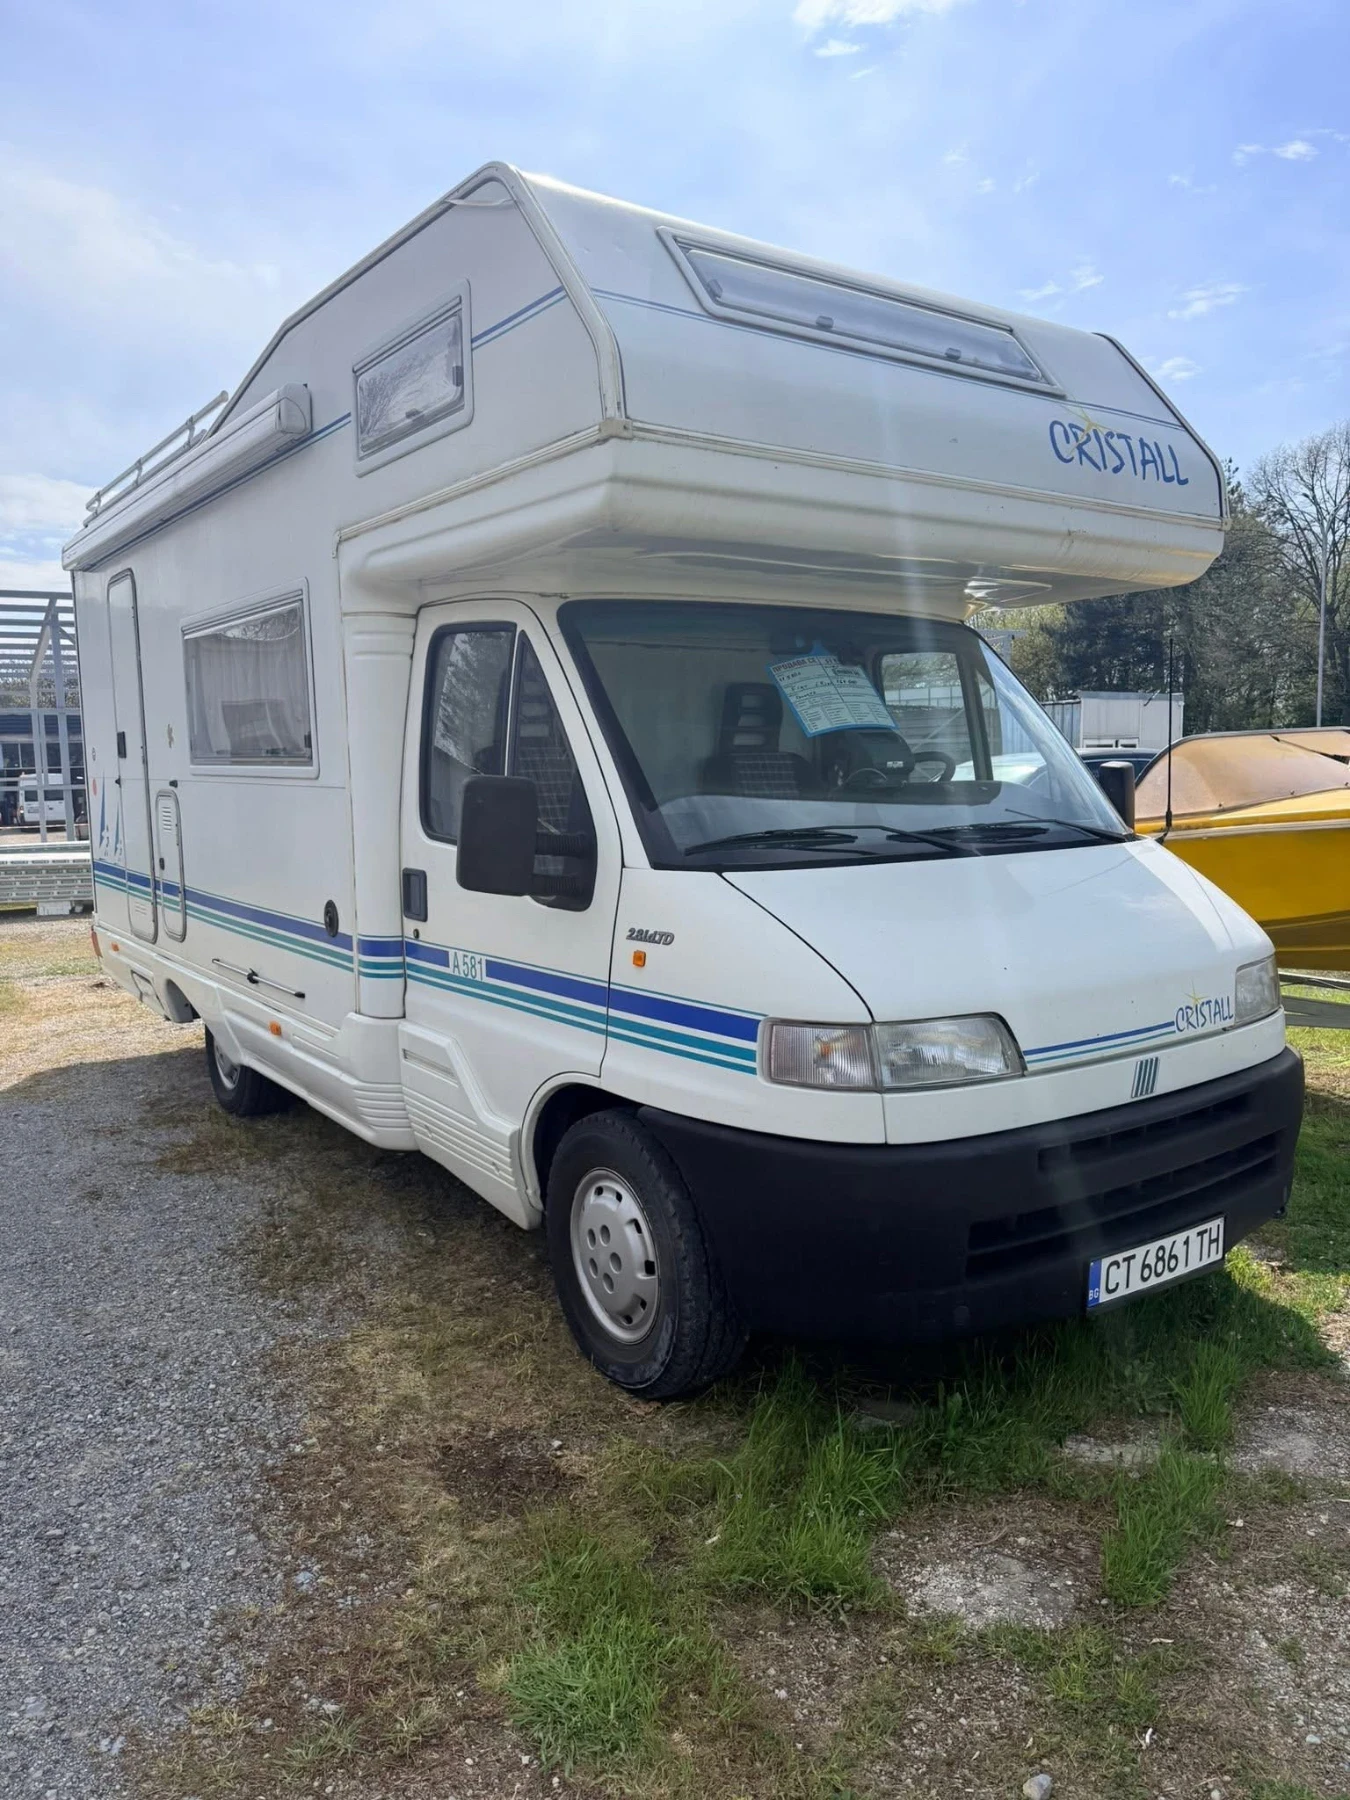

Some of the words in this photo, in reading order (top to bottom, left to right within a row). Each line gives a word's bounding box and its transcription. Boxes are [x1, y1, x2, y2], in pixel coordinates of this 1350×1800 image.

[1049, 420, 1189, 486] CRISTALL
[1175, 996, 1234, 1033] CRISTALL
[1140, 1235, 1189, 1282] 6861
[1088, 1287, 1099, 1301] BG
